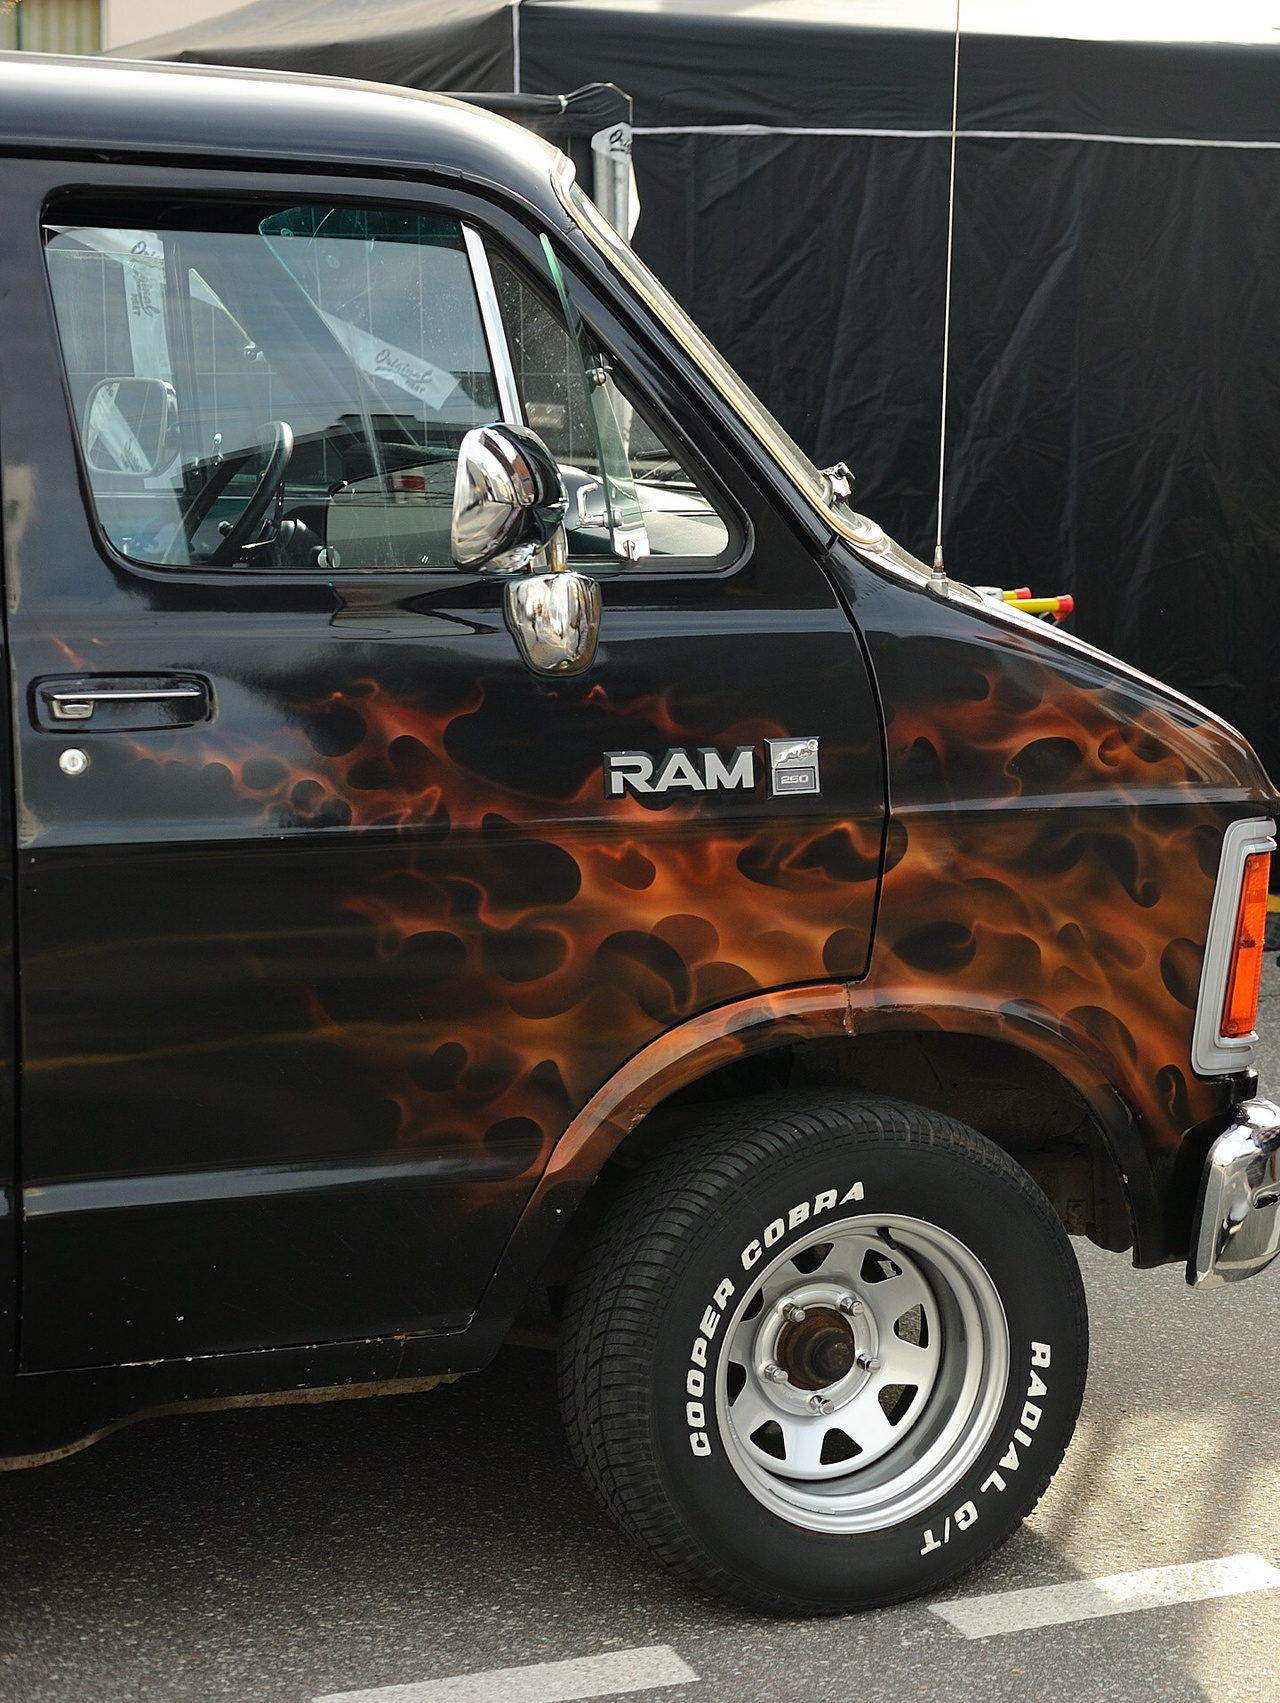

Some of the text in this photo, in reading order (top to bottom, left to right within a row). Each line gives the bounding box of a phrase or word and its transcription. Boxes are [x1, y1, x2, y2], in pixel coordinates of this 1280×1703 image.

[374, 349, 434, 384] Original
[604, 746, 755, 798] RAM
[780, 774, 810, 786] 250
[686, 1181, 865, 1458] COOPER COBRA
[920, 1341, 1051, 1556] RADIAL G/T
